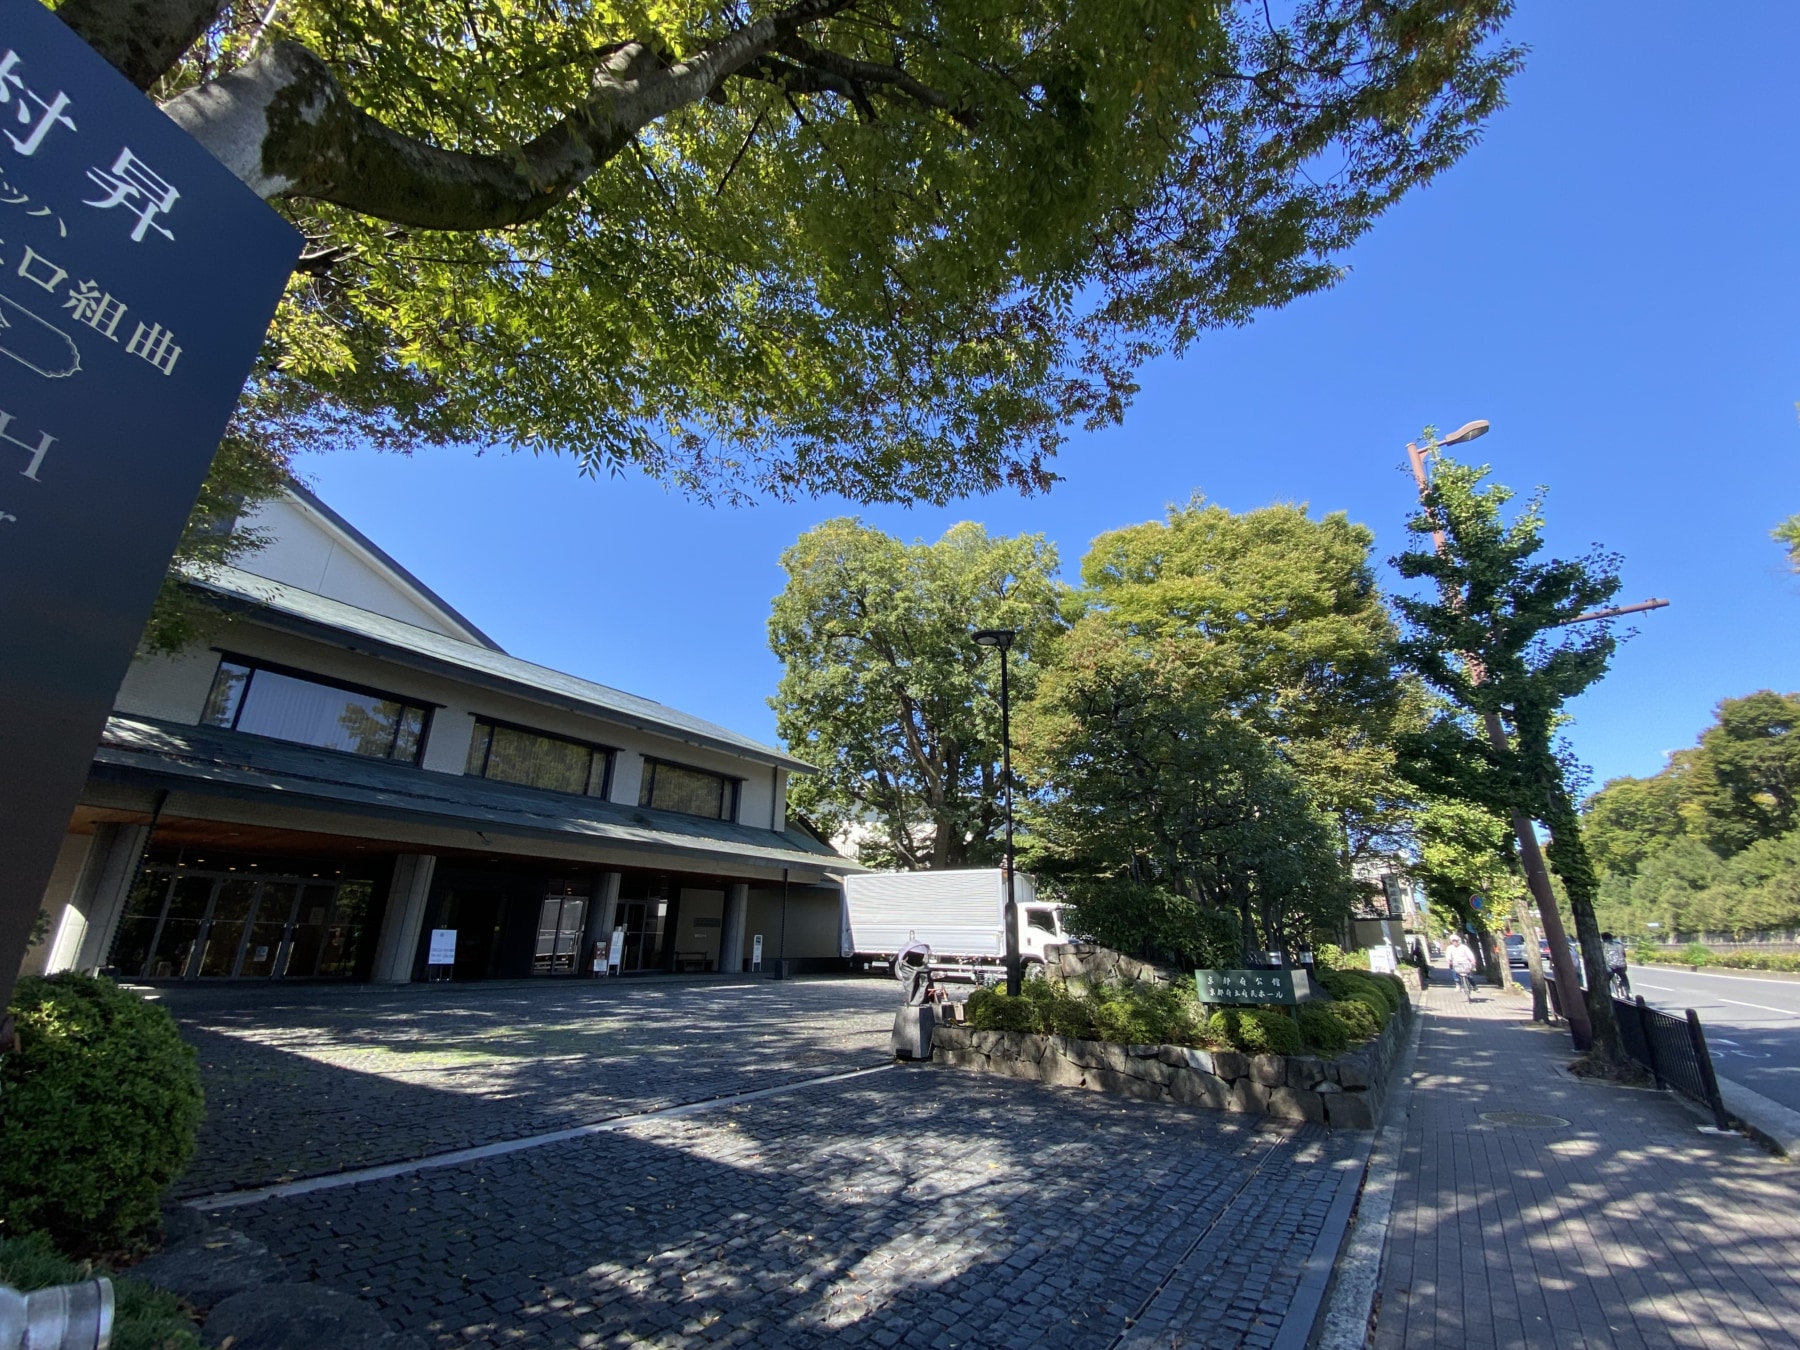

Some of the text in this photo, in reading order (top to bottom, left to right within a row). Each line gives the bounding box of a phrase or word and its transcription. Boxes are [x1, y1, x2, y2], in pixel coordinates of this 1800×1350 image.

[0, 167, 68, 238] ッハ
[0, 238, 183, 376] ロ組曲
